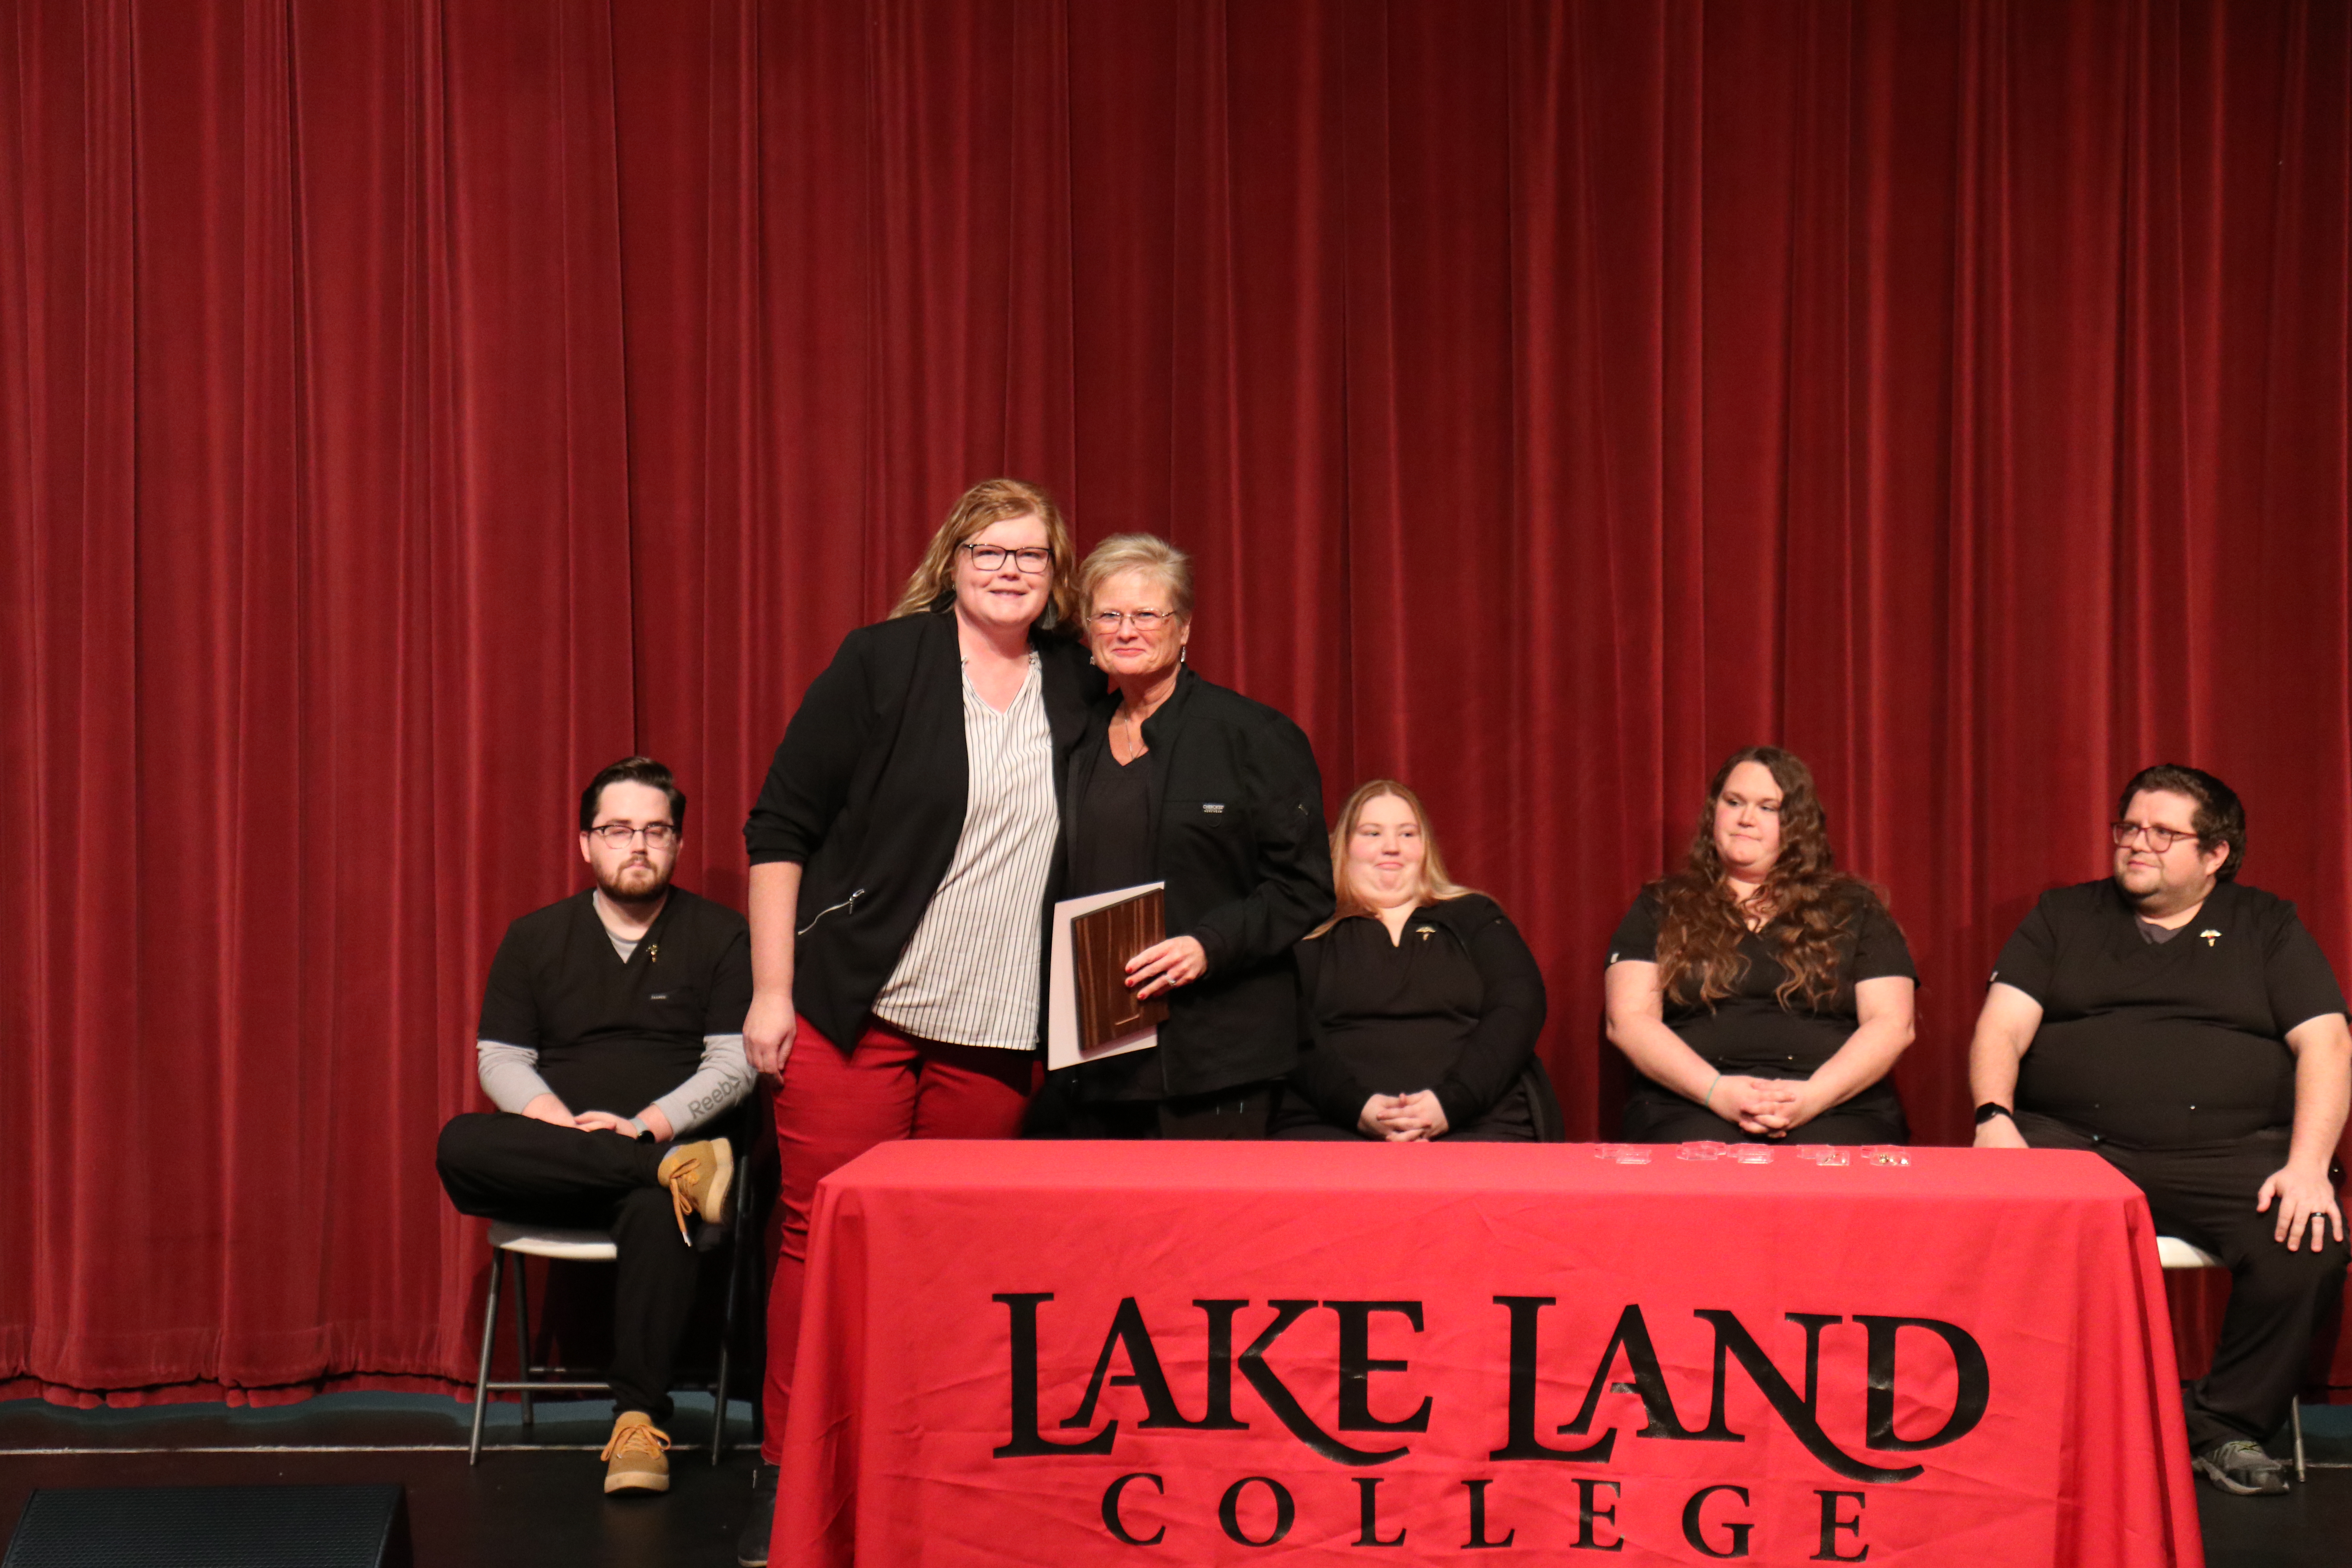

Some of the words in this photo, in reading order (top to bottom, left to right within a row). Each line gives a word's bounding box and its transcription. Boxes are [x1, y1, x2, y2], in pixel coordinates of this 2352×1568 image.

[688, 1076, 740, 1119] Reeb
[992, 1292, 1433, 1466] LAKE
[1489, 1295, 1990, 1483] LAND
[1101, 1472, 1869, 1562] COLLEGE
